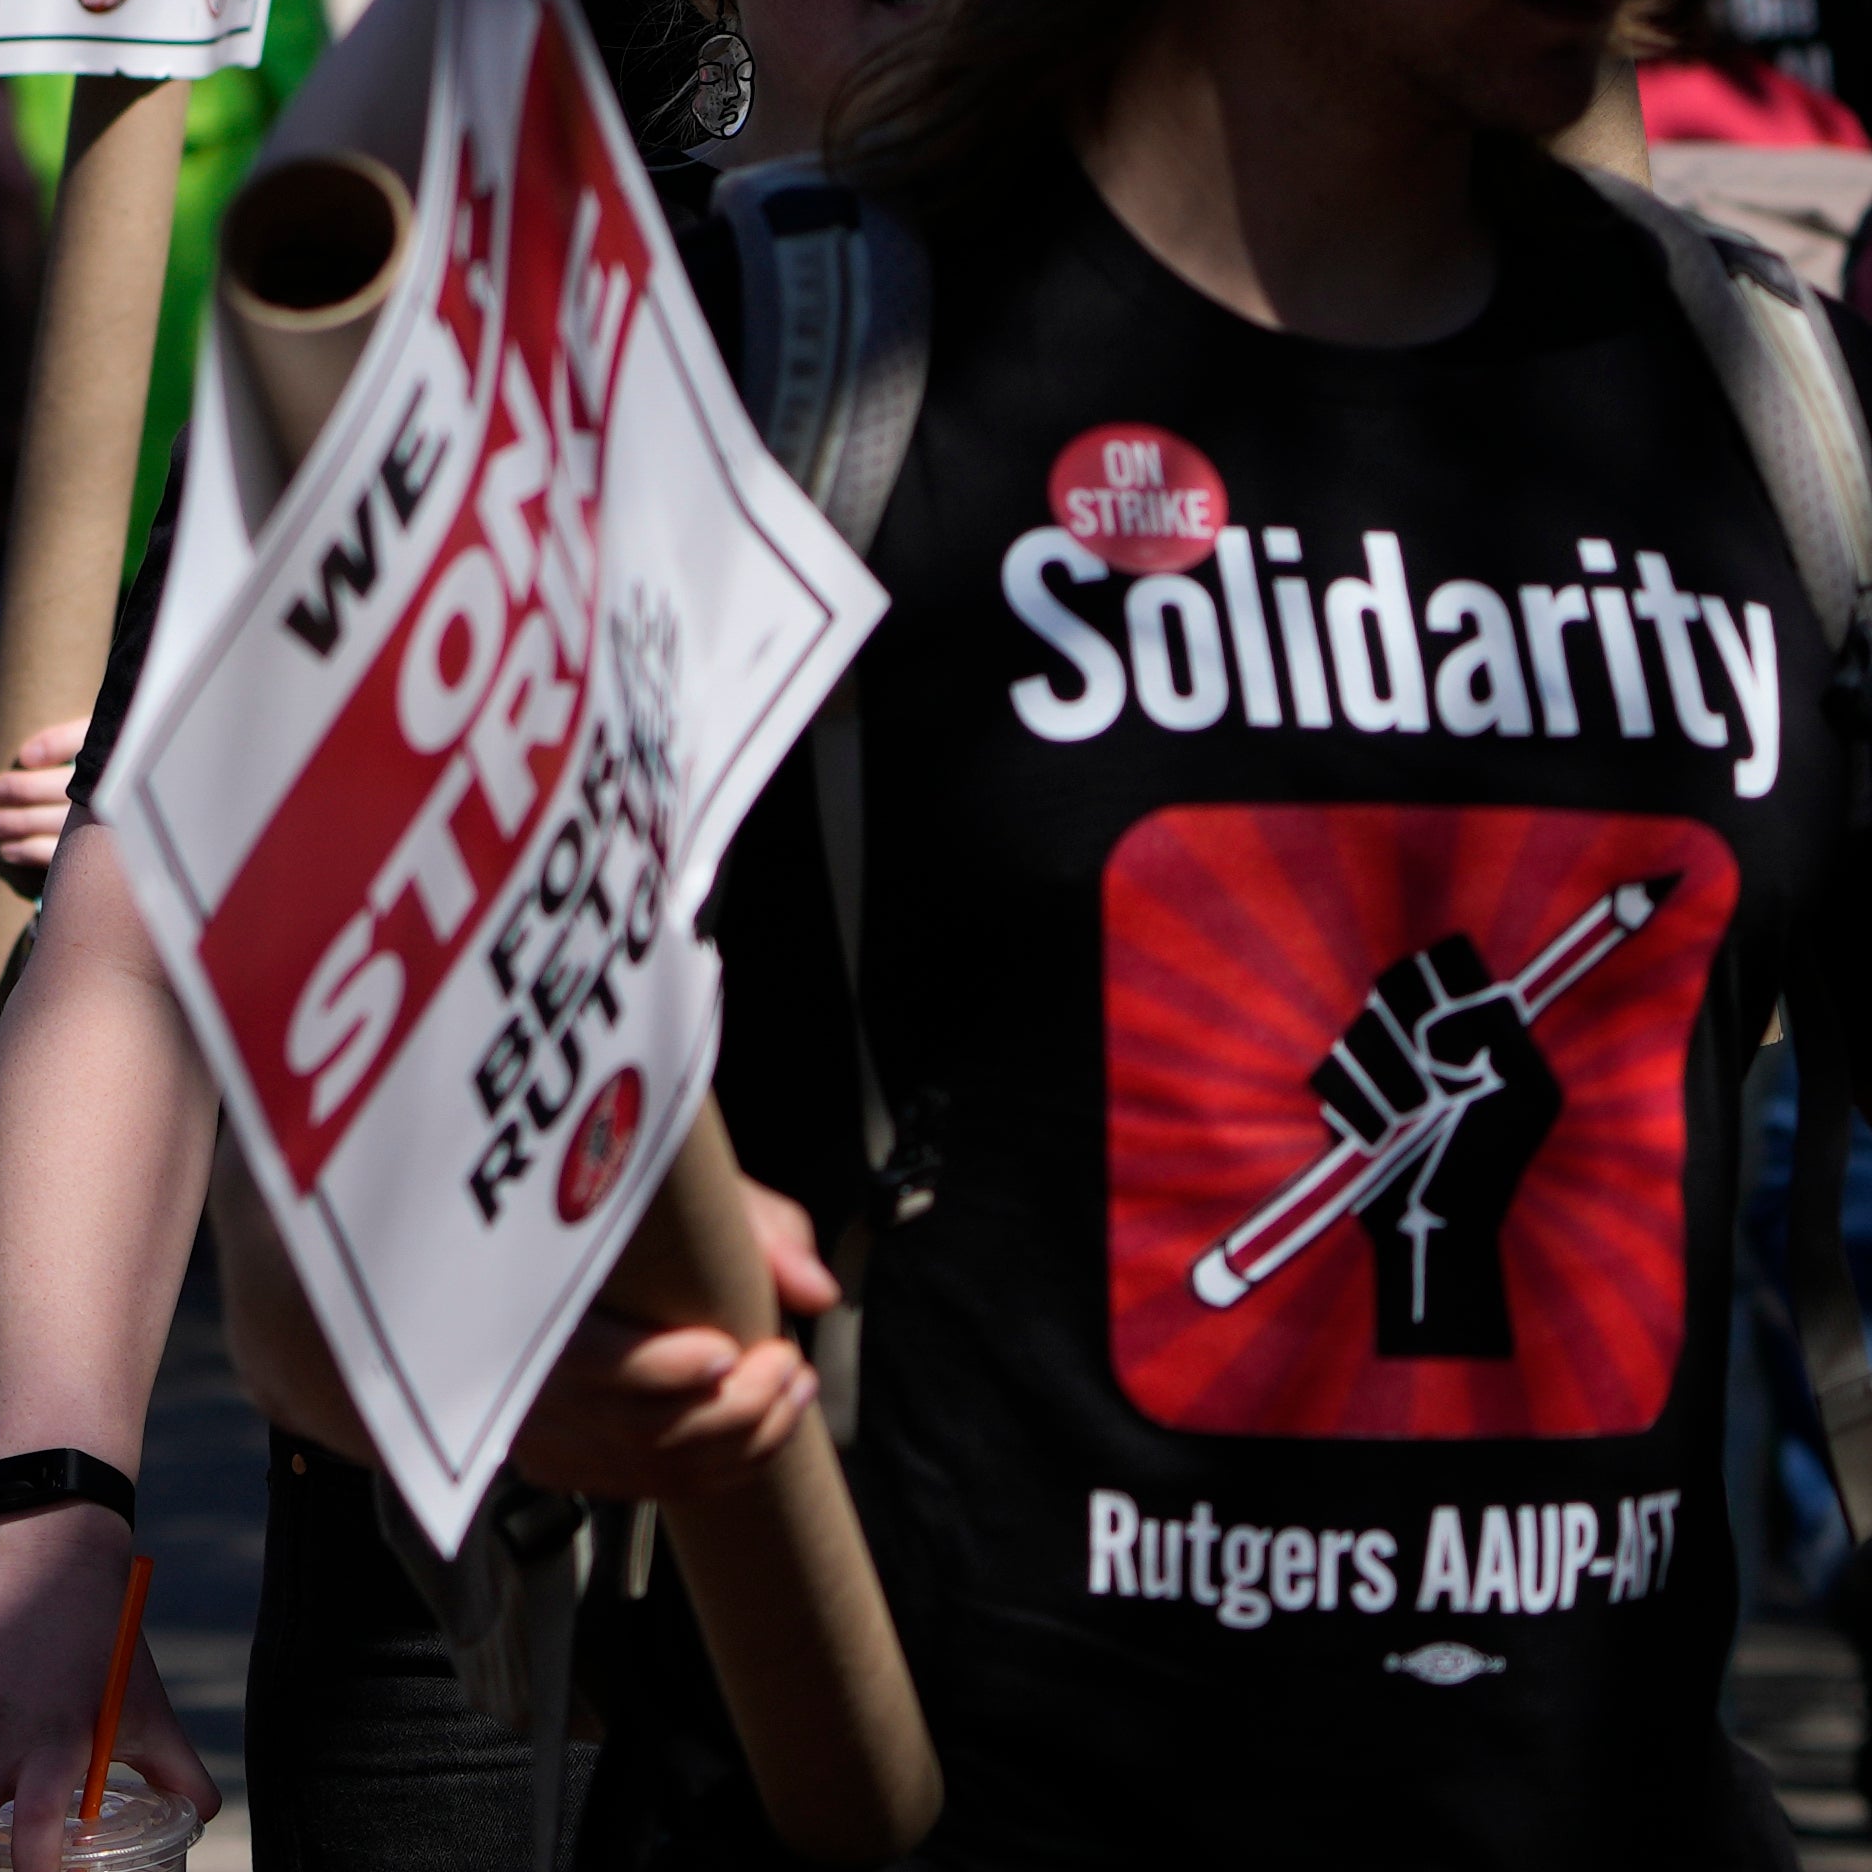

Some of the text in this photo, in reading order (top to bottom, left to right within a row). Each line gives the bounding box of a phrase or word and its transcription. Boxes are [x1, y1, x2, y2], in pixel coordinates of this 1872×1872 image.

[283, 380, 453, 659] WE
[396, 338, 552, 756] ON
[1066, 489, 1217, 542] STRIKE
[1104, 440, 1164, 488] ON
[1002, 524, 1782, 798] Solidarity
[1088, 1488, 1682, 1629] Rutgers AAUP-AFT
